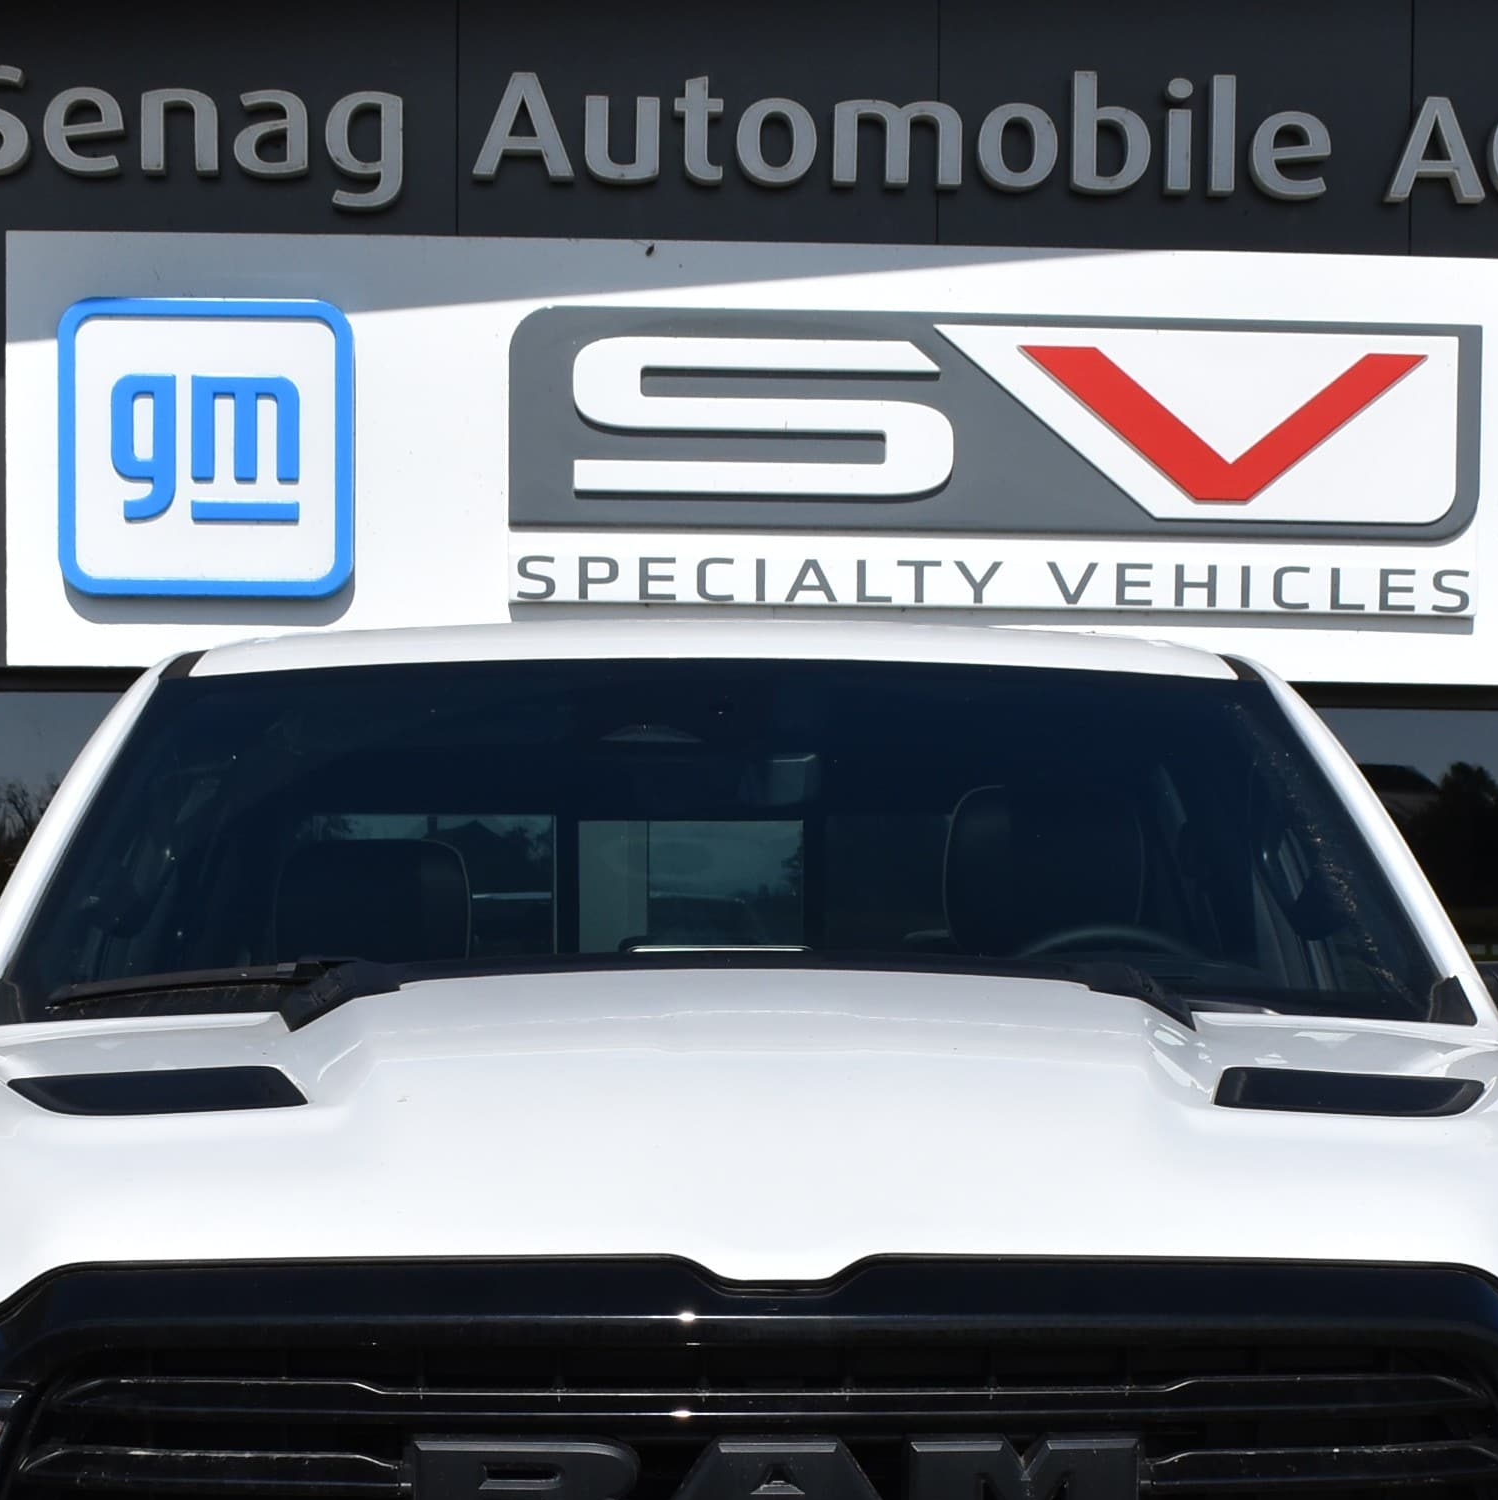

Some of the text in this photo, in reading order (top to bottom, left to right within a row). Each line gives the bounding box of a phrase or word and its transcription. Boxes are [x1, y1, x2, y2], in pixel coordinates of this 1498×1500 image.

[471, 70, 1333, 200] Automobile
[110, 373, 300, 523] gm
[516, 553, 1471, 614] SPECIALTY VEHICLES
